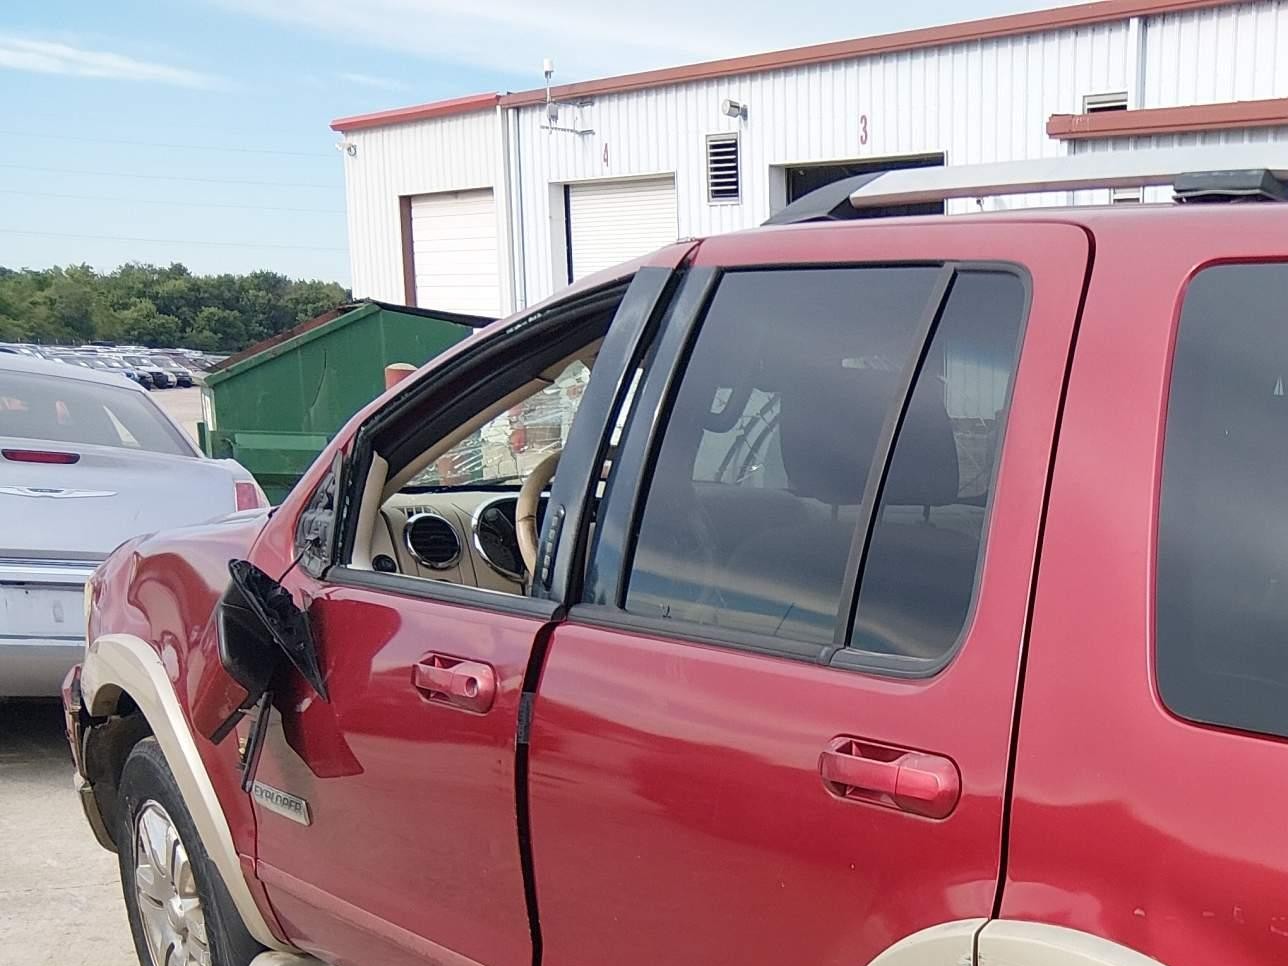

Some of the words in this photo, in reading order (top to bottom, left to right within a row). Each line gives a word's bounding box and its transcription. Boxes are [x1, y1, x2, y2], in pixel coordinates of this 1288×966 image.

[859, 114, 869, 145] 3
[602, 142, 609, 168] 4
[254, 785, 303, 815] EXPLORER
